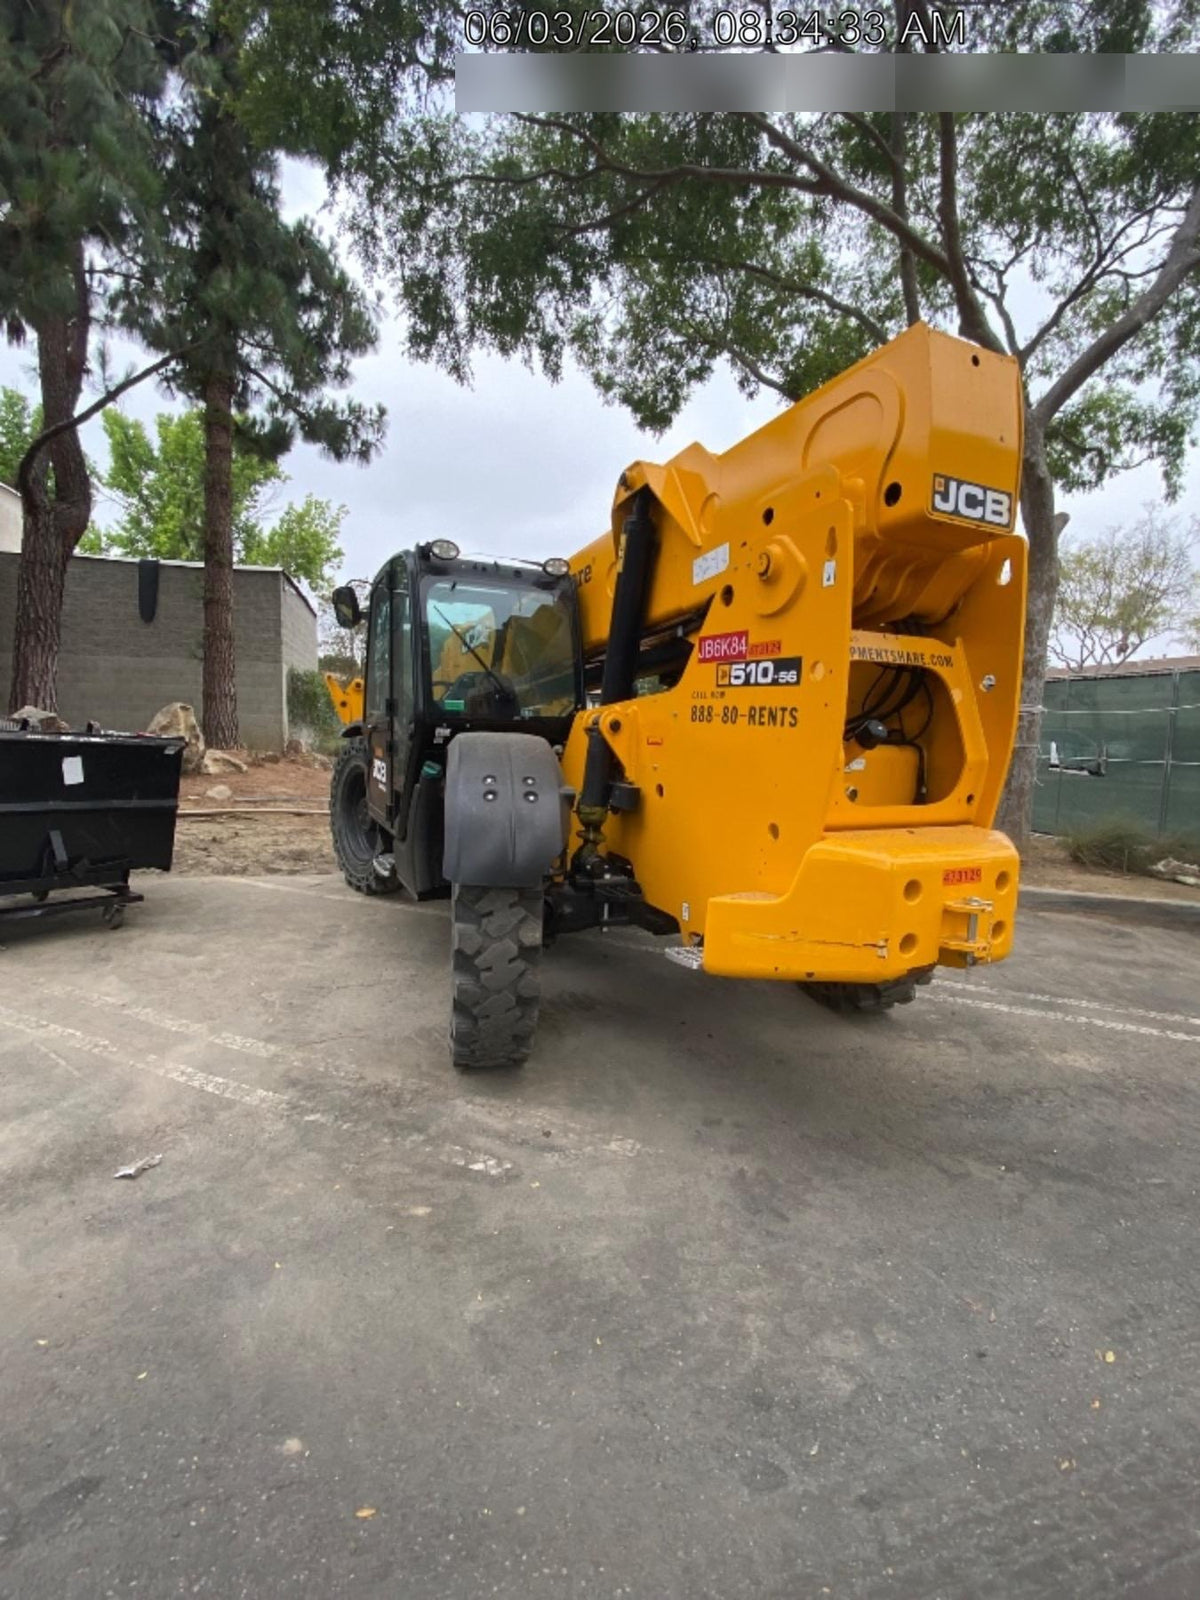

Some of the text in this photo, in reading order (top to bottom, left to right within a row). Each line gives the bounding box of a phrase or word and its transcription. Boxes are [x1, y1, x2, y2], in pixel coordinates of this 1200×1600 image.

[934, 480, 1010, 526] JCB
[573, 564, 592, 588] re
[698, 635, 748, 659] JB6K84
[690, 704, 799, 727] 888-80-RENTS
